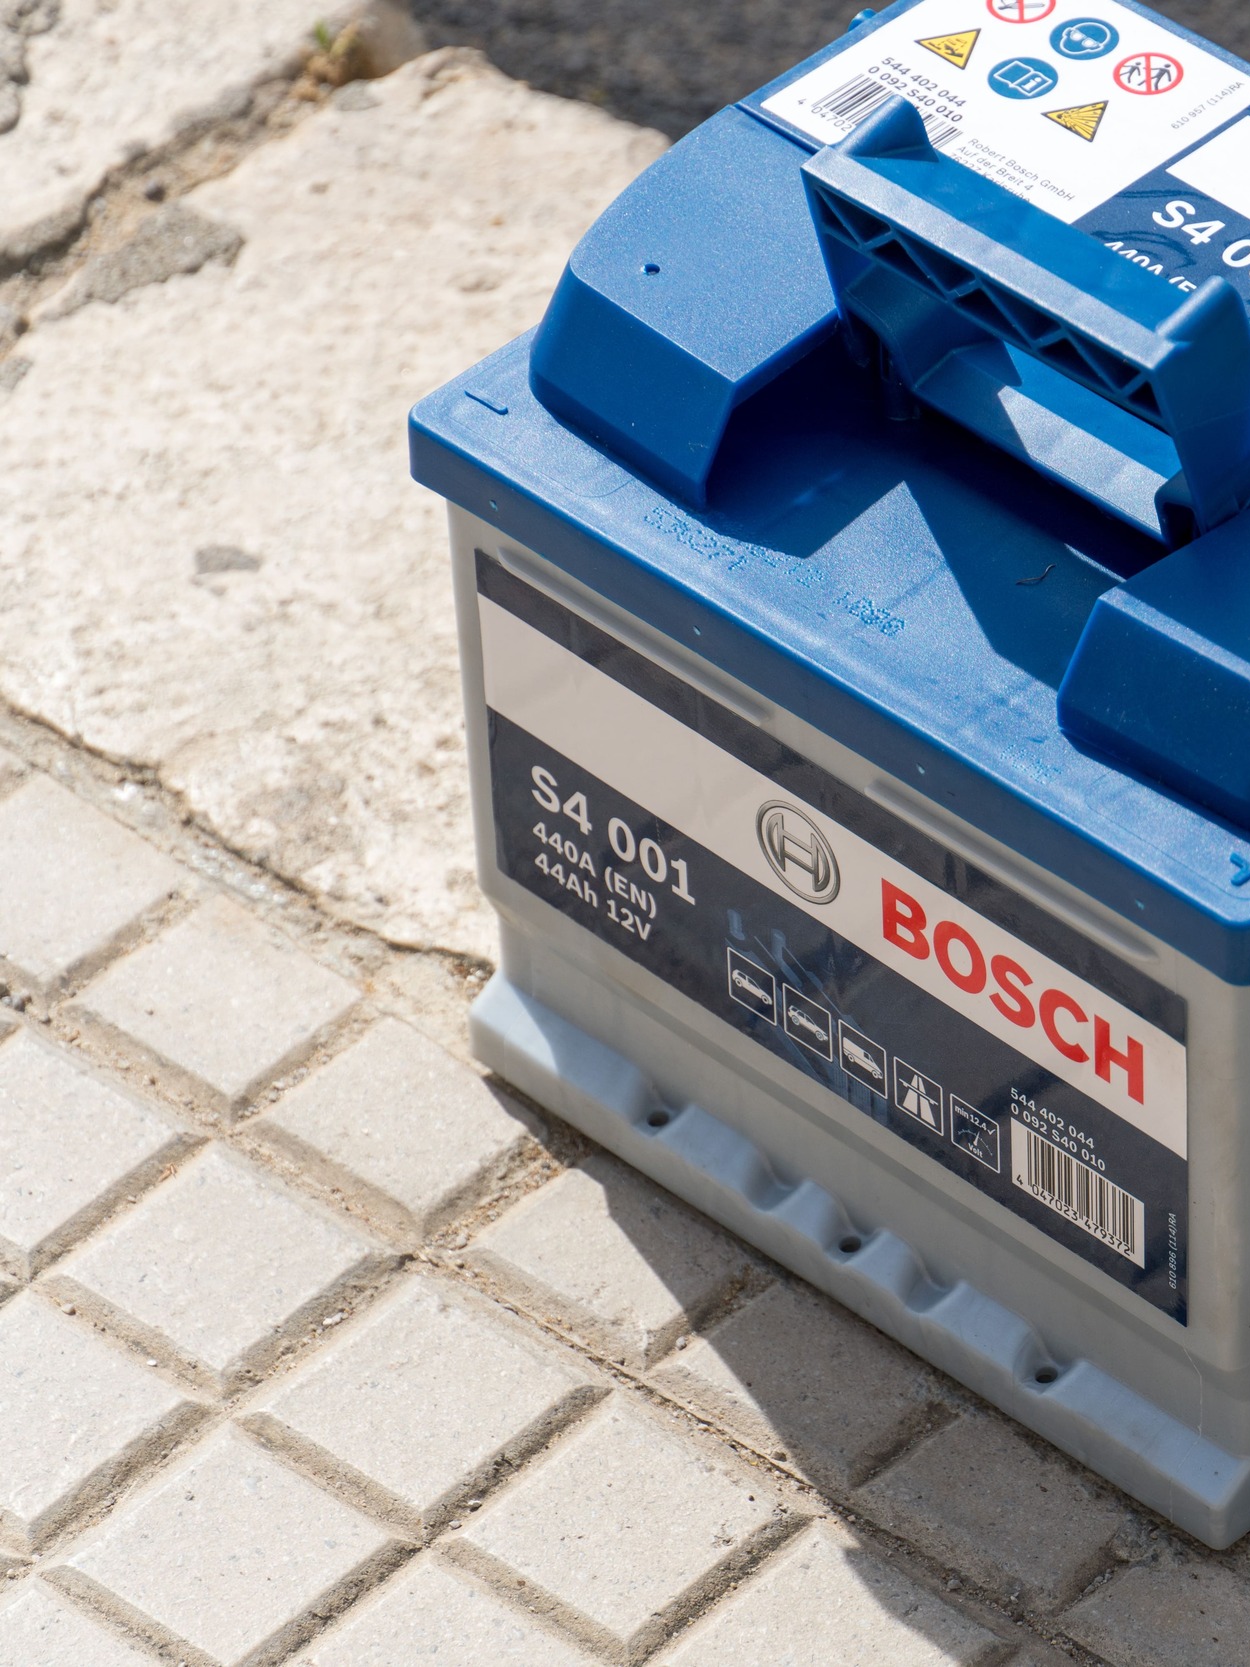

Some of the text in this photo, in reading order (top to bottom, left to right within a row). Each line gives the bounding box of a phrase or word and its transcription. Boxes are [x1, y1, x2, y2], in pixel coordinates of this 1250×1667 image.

[868, 66, 963, 123] 0 092 S40 010
[881, 57, 967, 108] 544 402 044
[797, 98, 853, 132] 4 04702
[1170, 116, 1191, 130] 610
[1188, 103, 1207, 118] 957
[958, 146, 1035, 192] Auf der Breit 4
[968, 138, 1076, 201] Robert Bosch GmbH
[1151, 200, 1226, 245] S4
[531, 765, 696, 906] S4 001
[532, 821, 657, 919] 440A (EN)
[534, 852, 652, 942] 44Ah 12V
[881, 877, 1145, 1106] BOSCH
[954, 1105, 987, 1131] min 12.4
[1010, 1087, 1095, 1150] 544 402 044
[1010, 1103, 1106, 1172] 0 092 S40 010
[968, 1142, 983, 1158] Volt
[1016, 1174, 1132, 1257] 4 047023 479372
[1168, 1251, 1177, 1271] 896
[1168, 1270, 1177, 1290] 610
